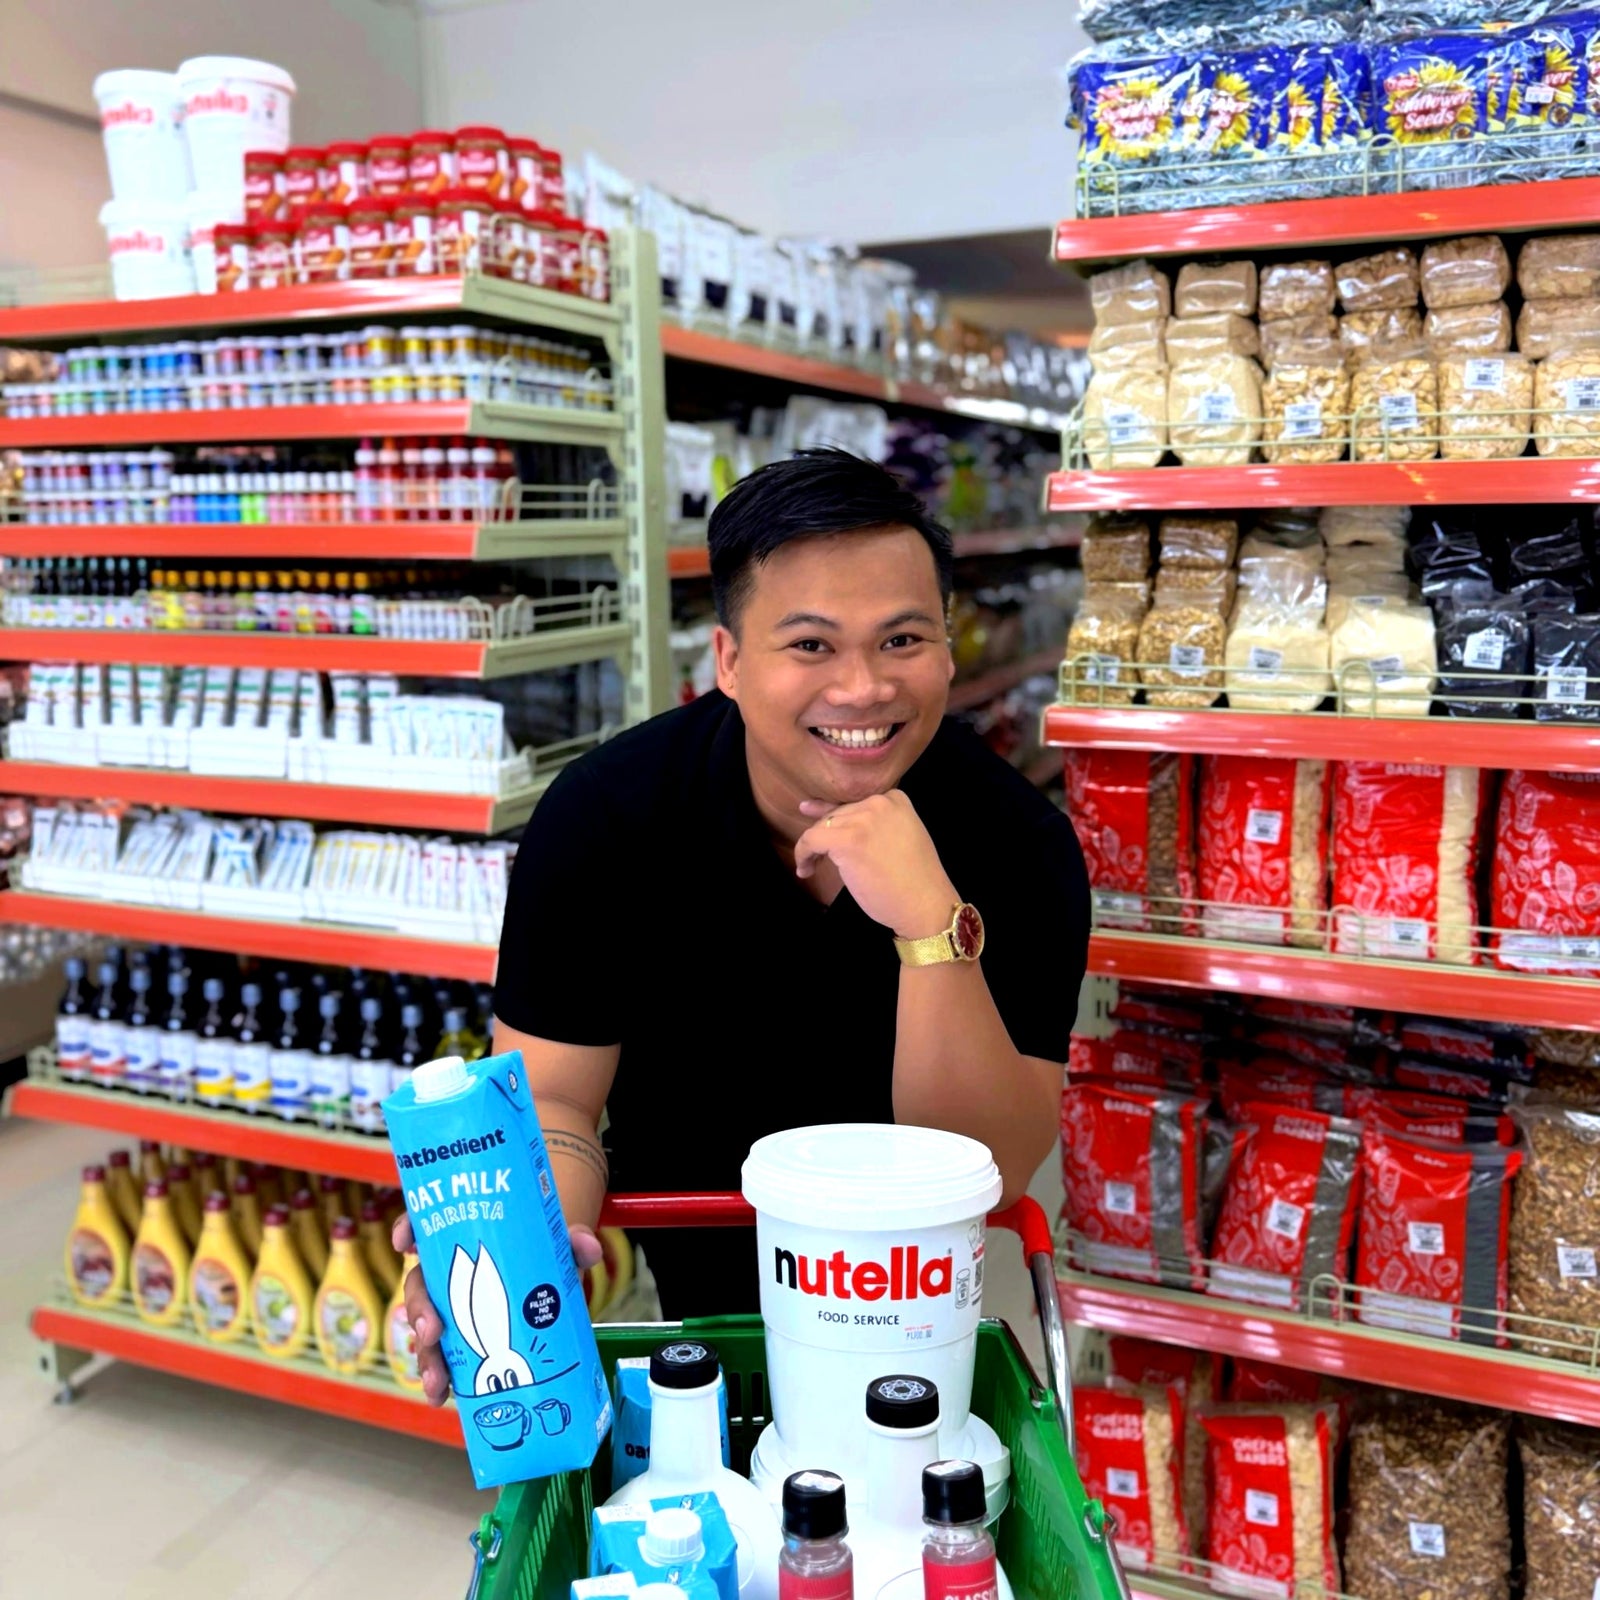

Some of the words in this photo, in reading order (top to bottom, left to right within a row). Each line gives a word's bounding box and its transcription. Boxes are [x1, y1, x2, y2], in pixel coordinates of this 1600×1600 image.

[1403, 107, 1456, 131] Seeds
[407, 1178, 445, 1213] OAT
[420, 1200, 504, 1237] BARISTA
[775, 1245, 953, 1301] nutella
[537, 1289, 548, 1299] NO
[538, 1305, 550, 1315] NO
[818, 1310, 849, 1325] FOOD
[854, 1314, 900, 1326] SERVICE
